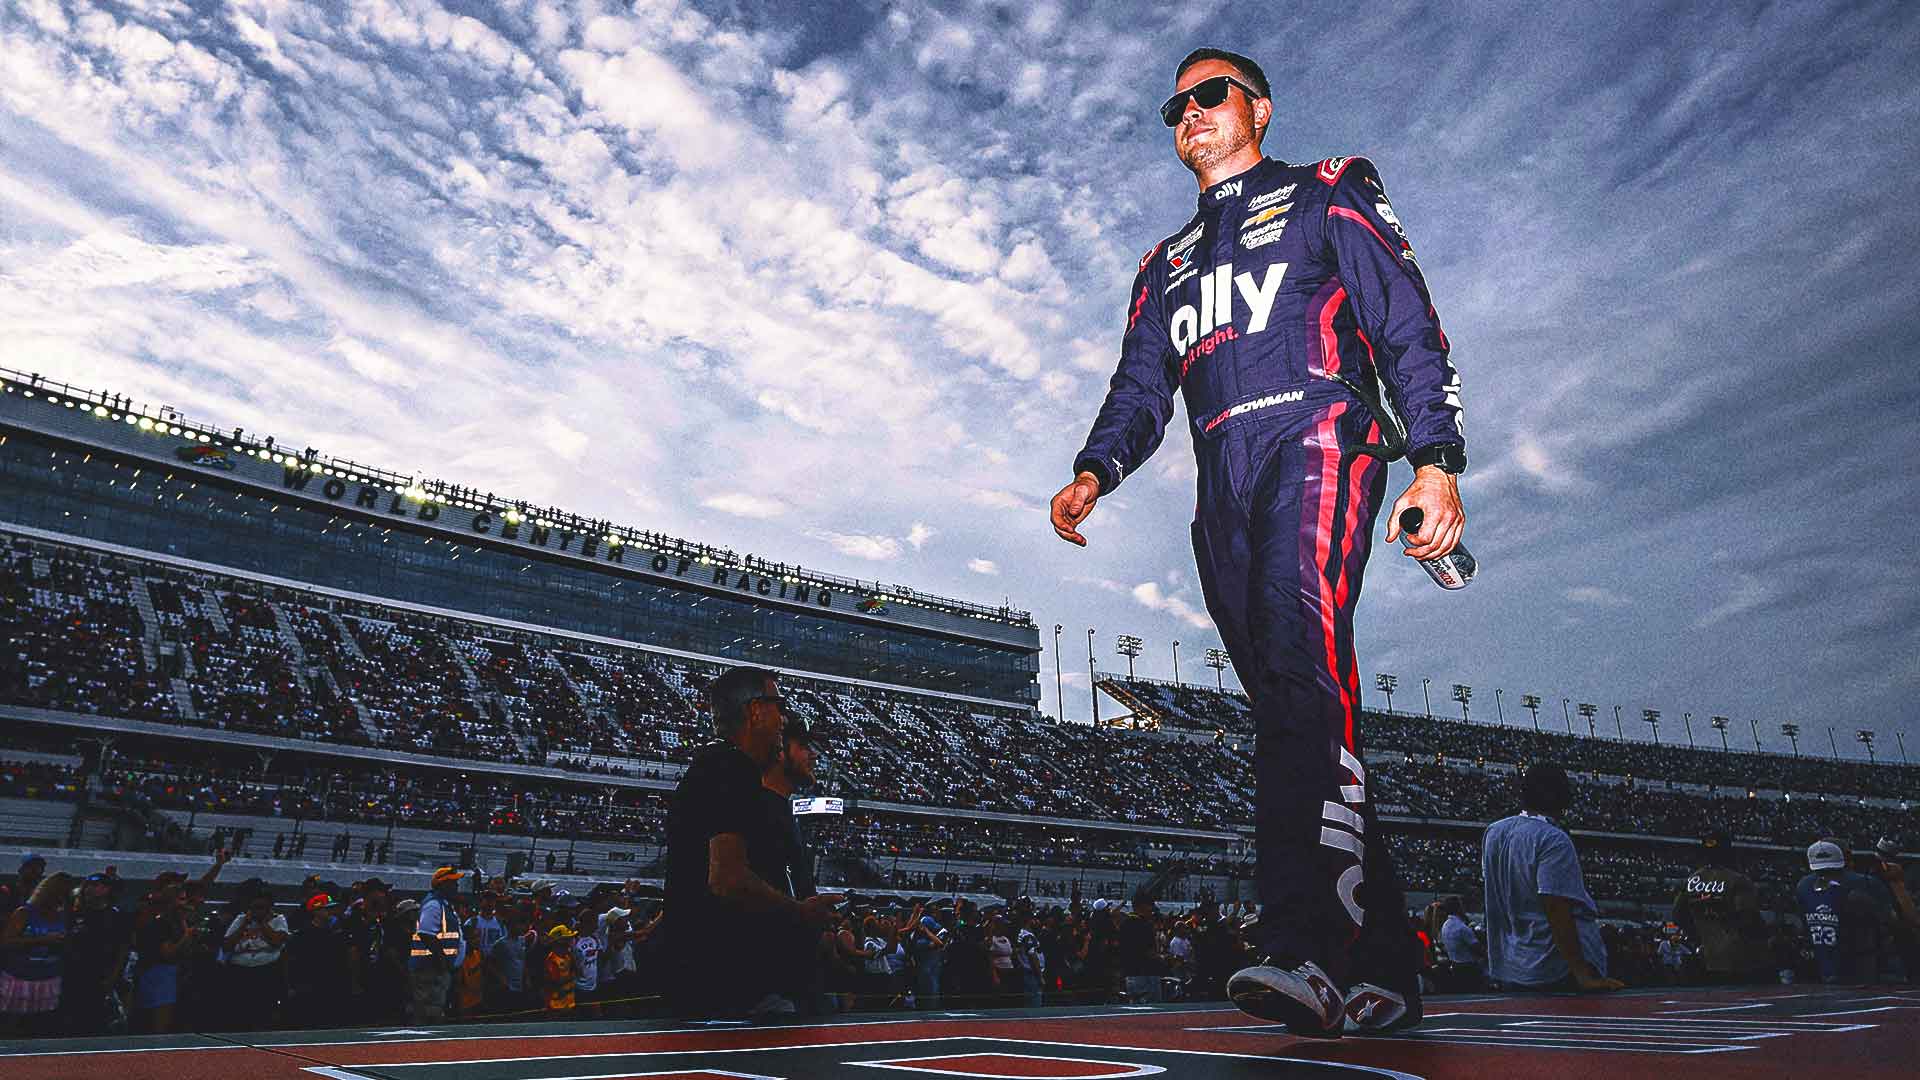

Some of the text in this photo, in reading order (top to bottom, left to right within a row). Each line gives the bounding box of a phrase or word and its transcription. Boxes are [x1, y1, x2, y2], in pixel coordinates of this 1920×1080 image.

[1215, 180, 1243, 200] ally
[1170, 263, 1288, 356] ally
[1229, 390, 1305, 417] BOWMAN
[283, 464, 832, 608] WORLD CENTER OF RACING
